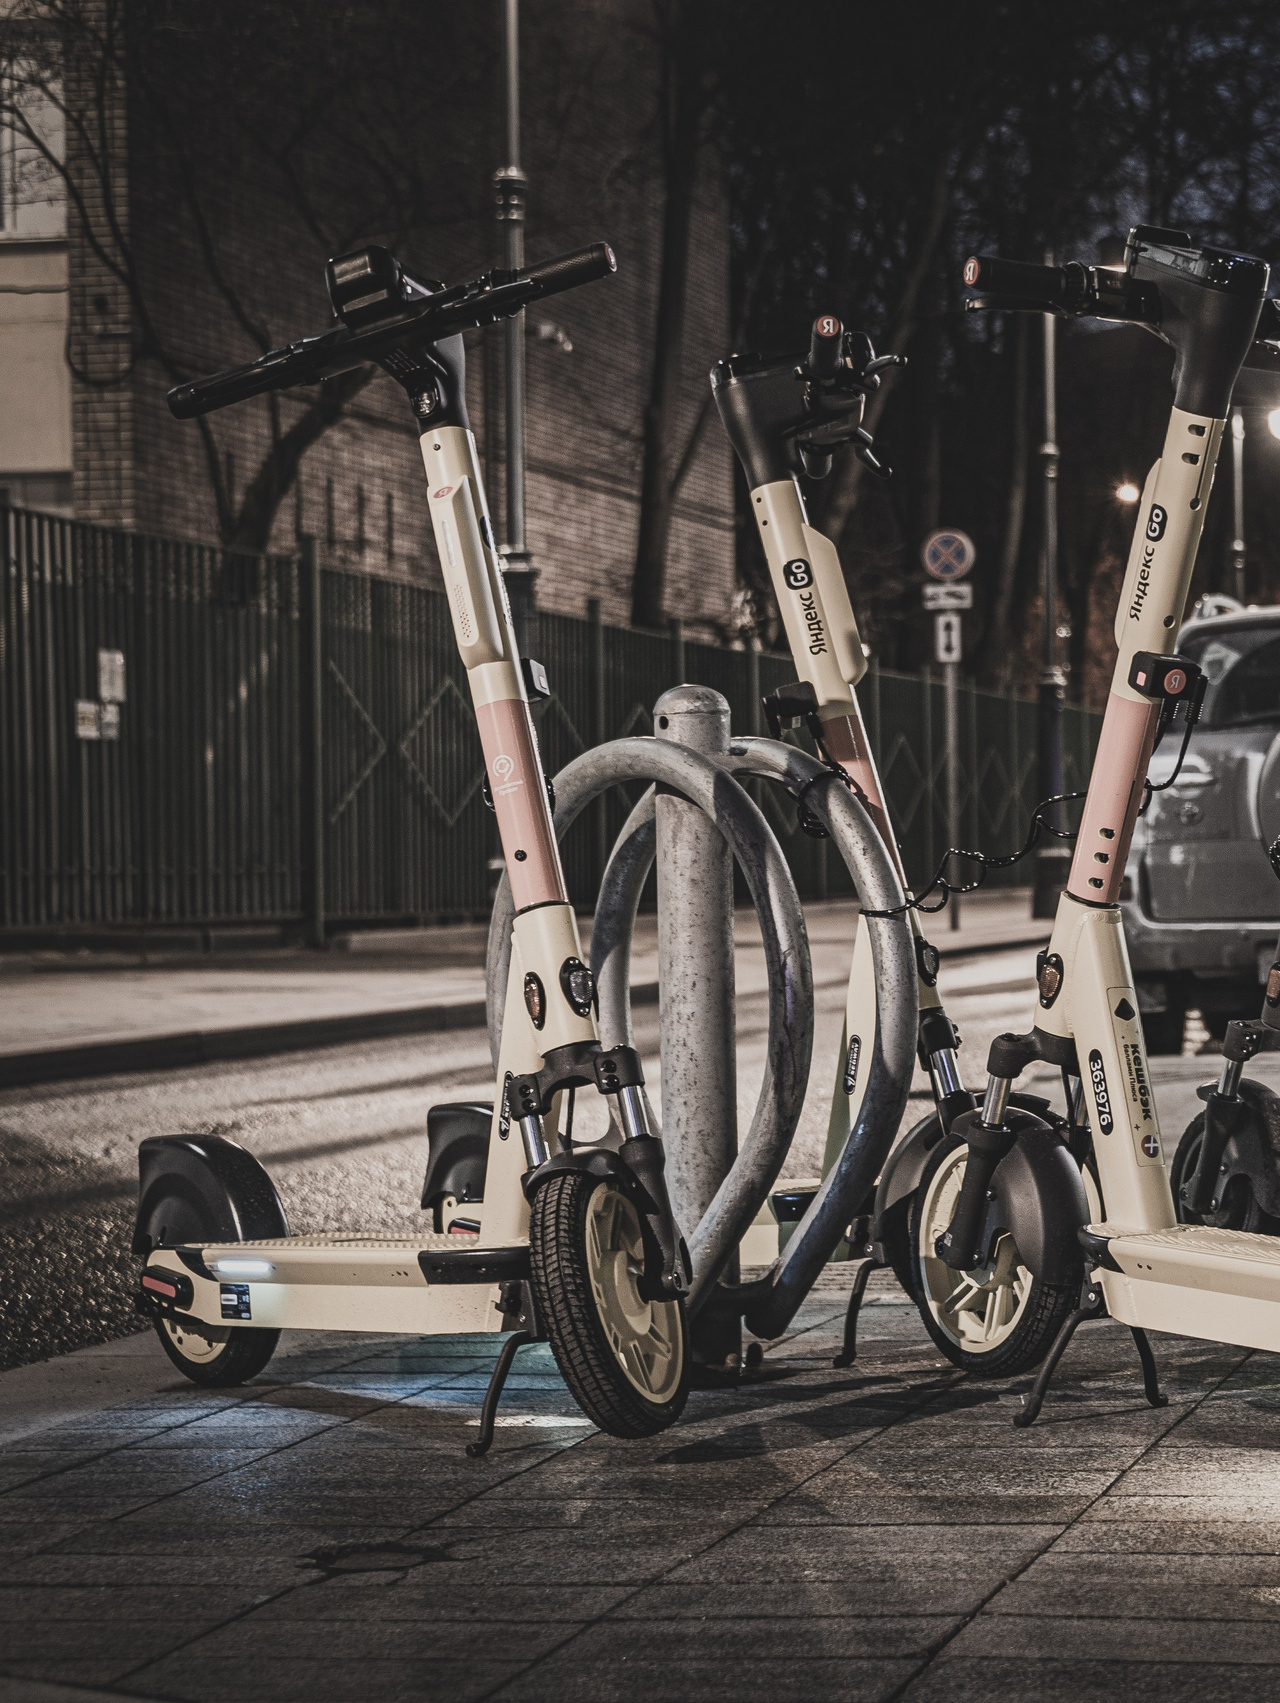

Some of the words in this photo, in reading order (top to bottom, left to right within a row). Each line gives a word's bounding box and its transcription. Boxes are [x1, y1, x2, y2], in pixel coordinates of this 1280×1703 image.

[966, 262, 975, 281] Я
[822, 318, 834, 334] Я
[789, 561, 809, 587] Go
[1129, 545, 1156, 622] Яндекс
[1147, 508, 1164, 538] Go
[799, 591, 828, 656] Яндекс
[1170, 674, 1181, 689] Я
[1090, 1058, 1112, 1126] 363976
[1122, 1043, 1134, 1078] баллами
[1128, 1077, 1138, 1103] Плюса
[1130, 1043, 1153, 1122] кешбэк
